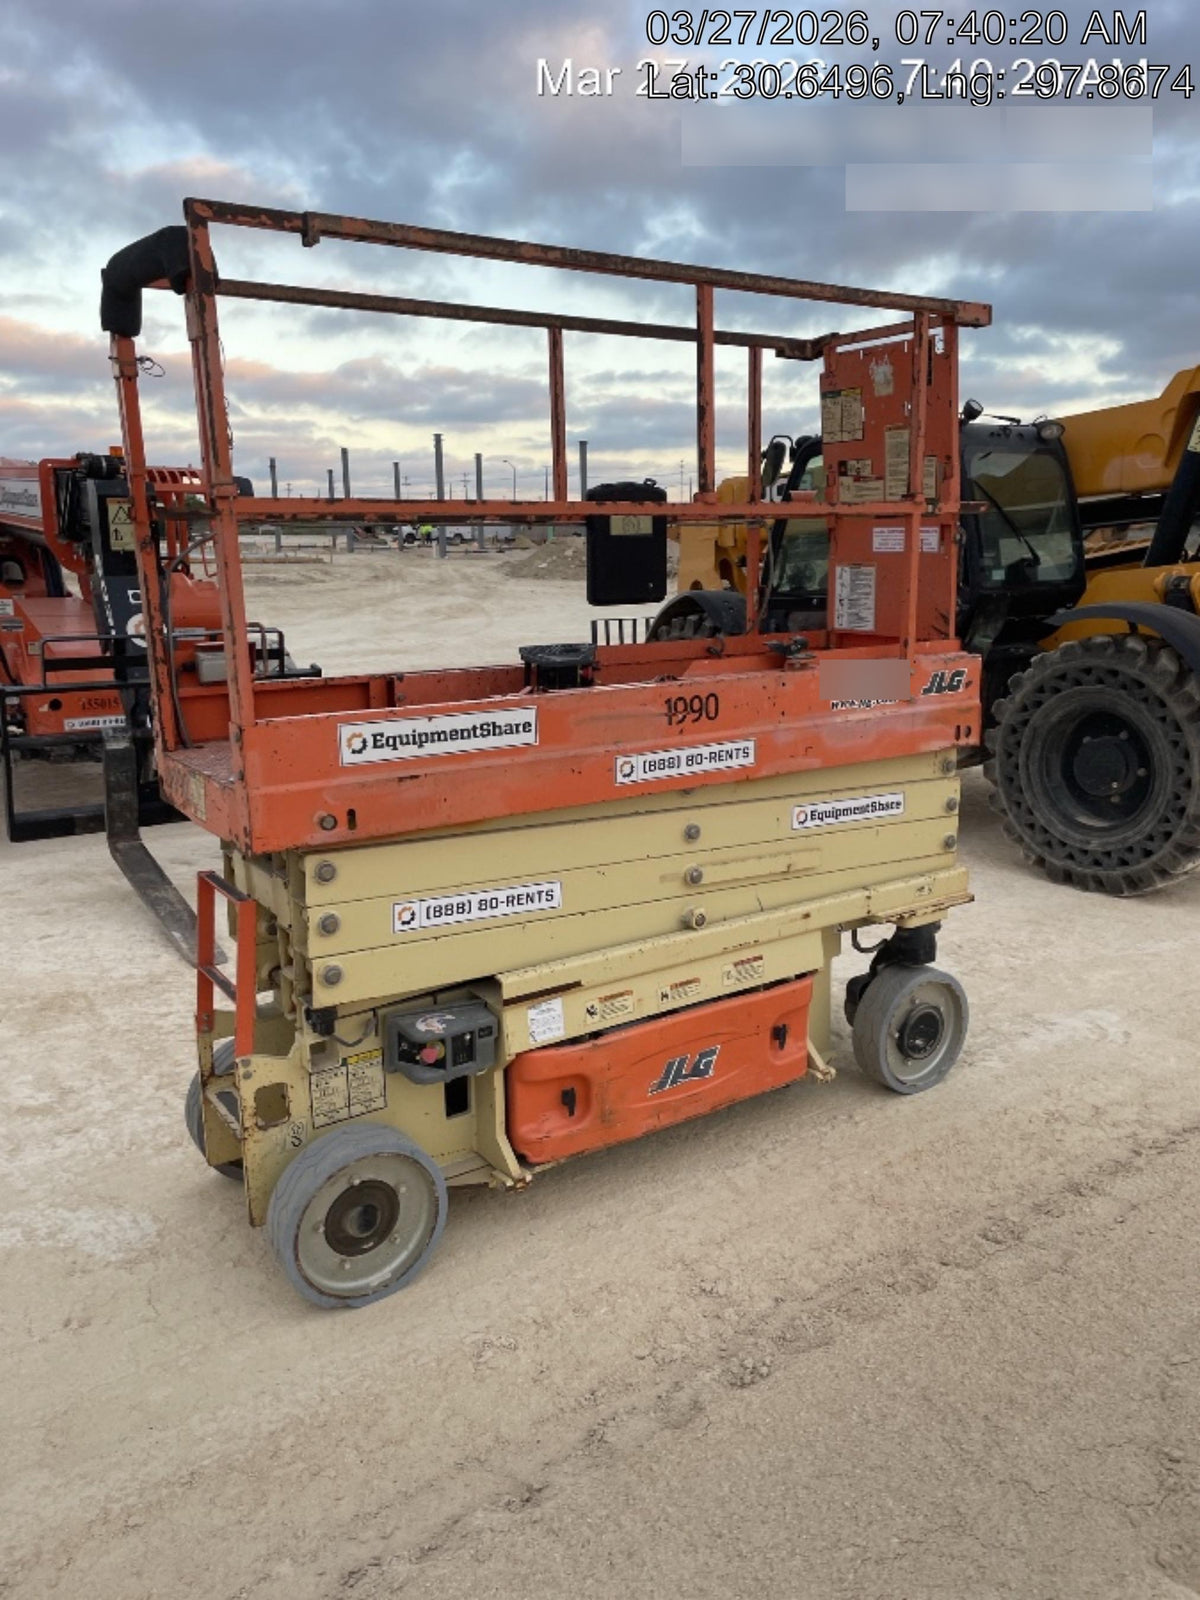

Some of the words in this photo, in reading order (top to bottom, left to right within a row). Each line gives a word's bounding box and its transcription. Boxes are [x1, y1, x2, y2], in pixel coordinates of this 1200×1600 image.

[921, 668, 969, 697] JLG
[664, 692, 719, 726] 1990
[371, 720, 532, 752] EquipmentShare
[642, 755, 680, 774] (888)
[685, 746, 750, 767] 80-RENTS
[809, 800, 902, 822] EquipmentShare
[425, 900, 472, 920] (888)
[477, 888, 554, 911] 80-RENTS
[647, 1045, 721, 1097] JLG
